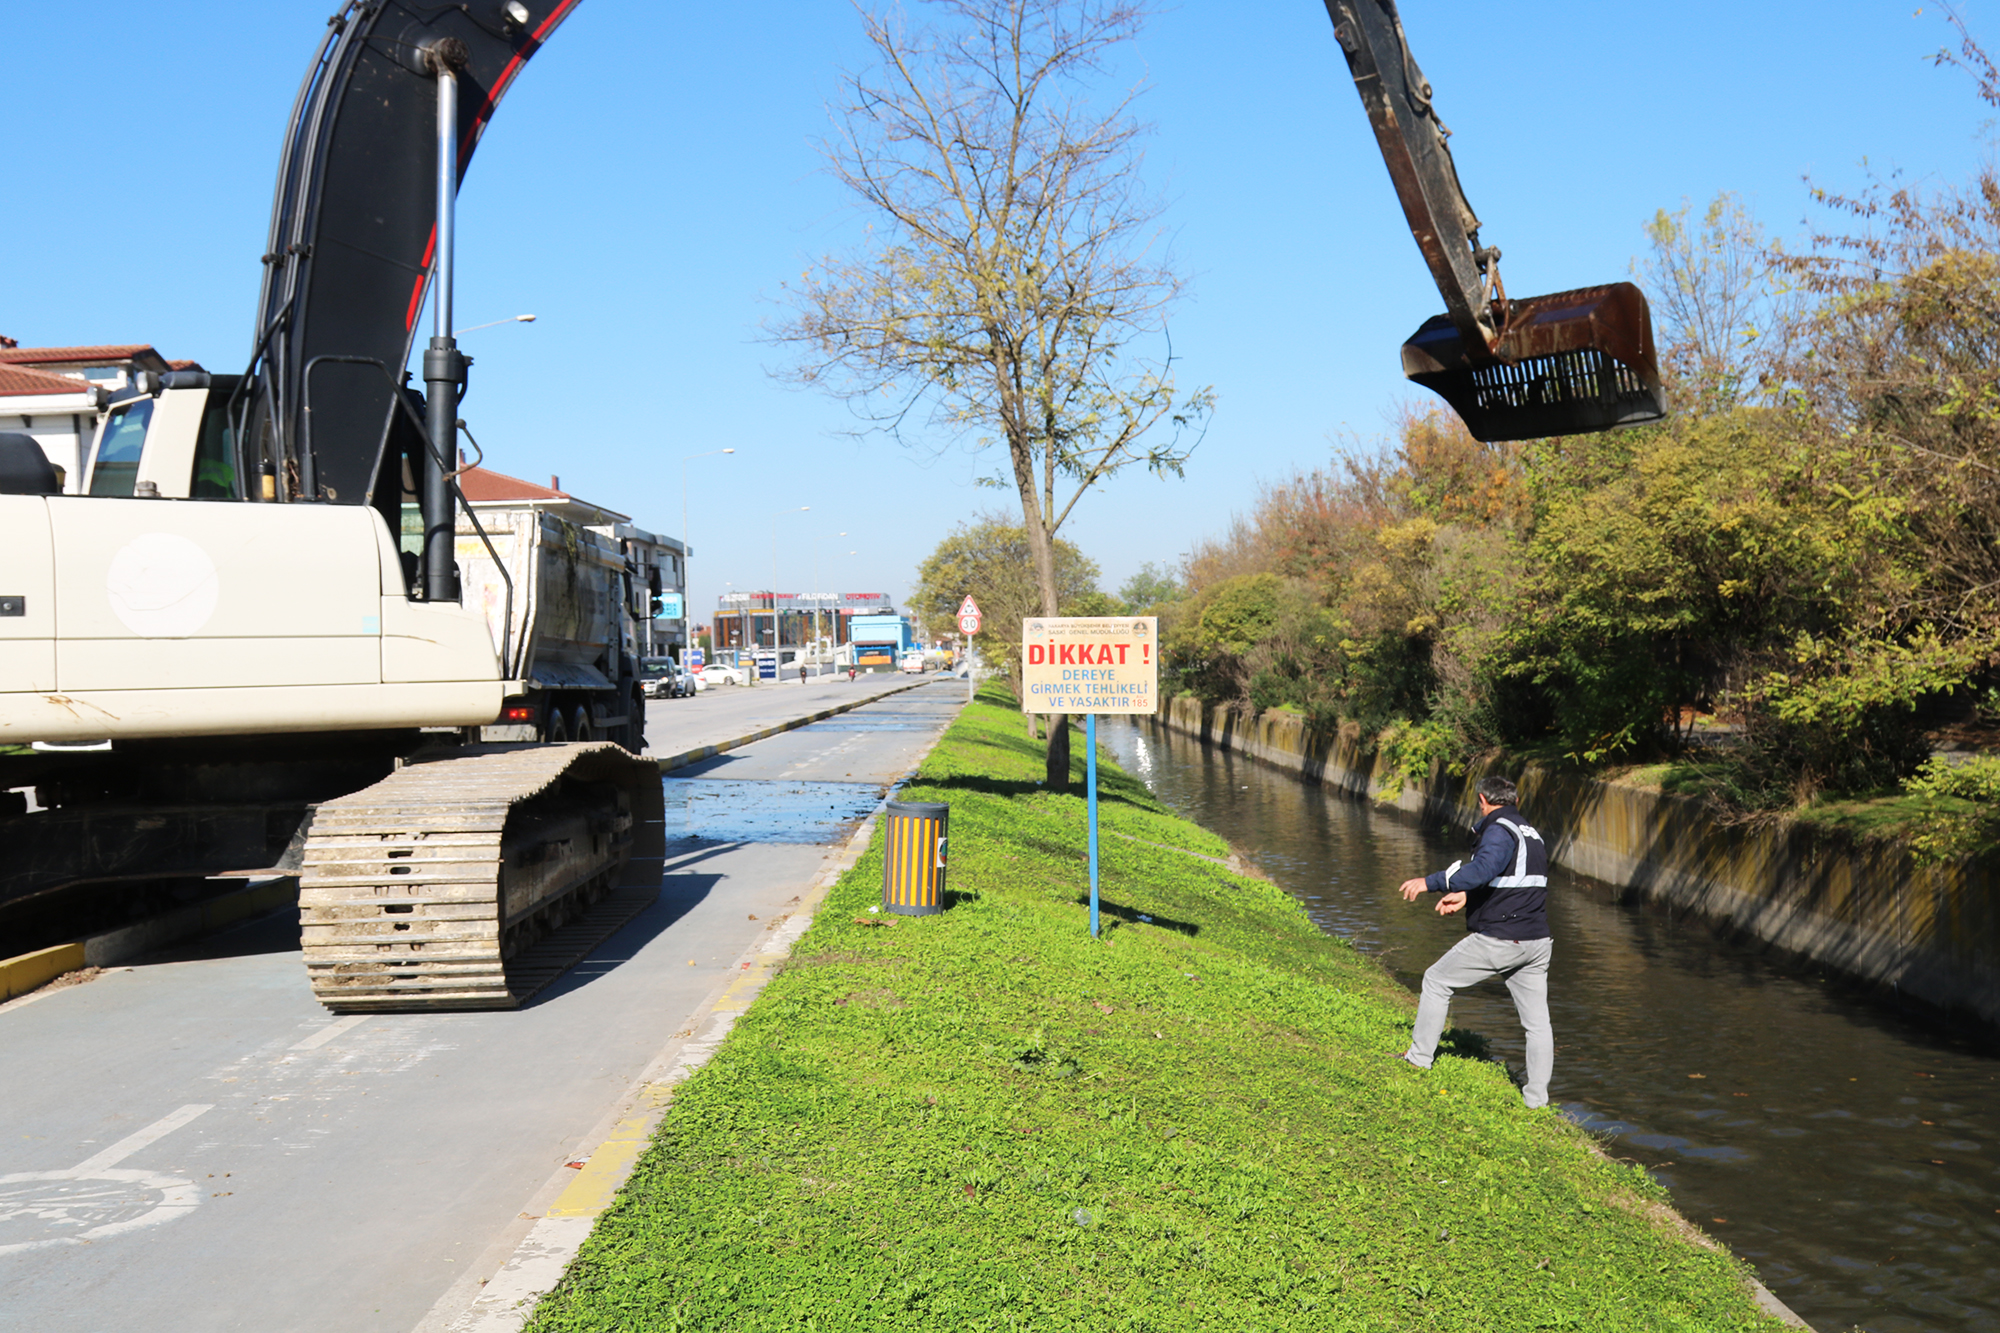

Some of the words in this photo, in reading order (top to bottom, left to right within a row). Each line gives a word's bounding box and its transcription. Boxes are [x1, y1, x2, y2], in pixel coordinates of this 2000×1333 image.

[963, 619, 976, 629] 30
[1029, 639, 1130, 665] DİKKAT
[1143, 644, 1149, 664] !
[1062, 669, 1115, 681] DEREYE
[1031, 681, 1081, 694] GİRMEK
[1085, 681, 1148, 694] TEHLİKELİ
[1048, 697, 1064, 707] VE
[1069, 697, 1129, 707] YASAKTIR
[1132, 699, 1148, 707] 185
